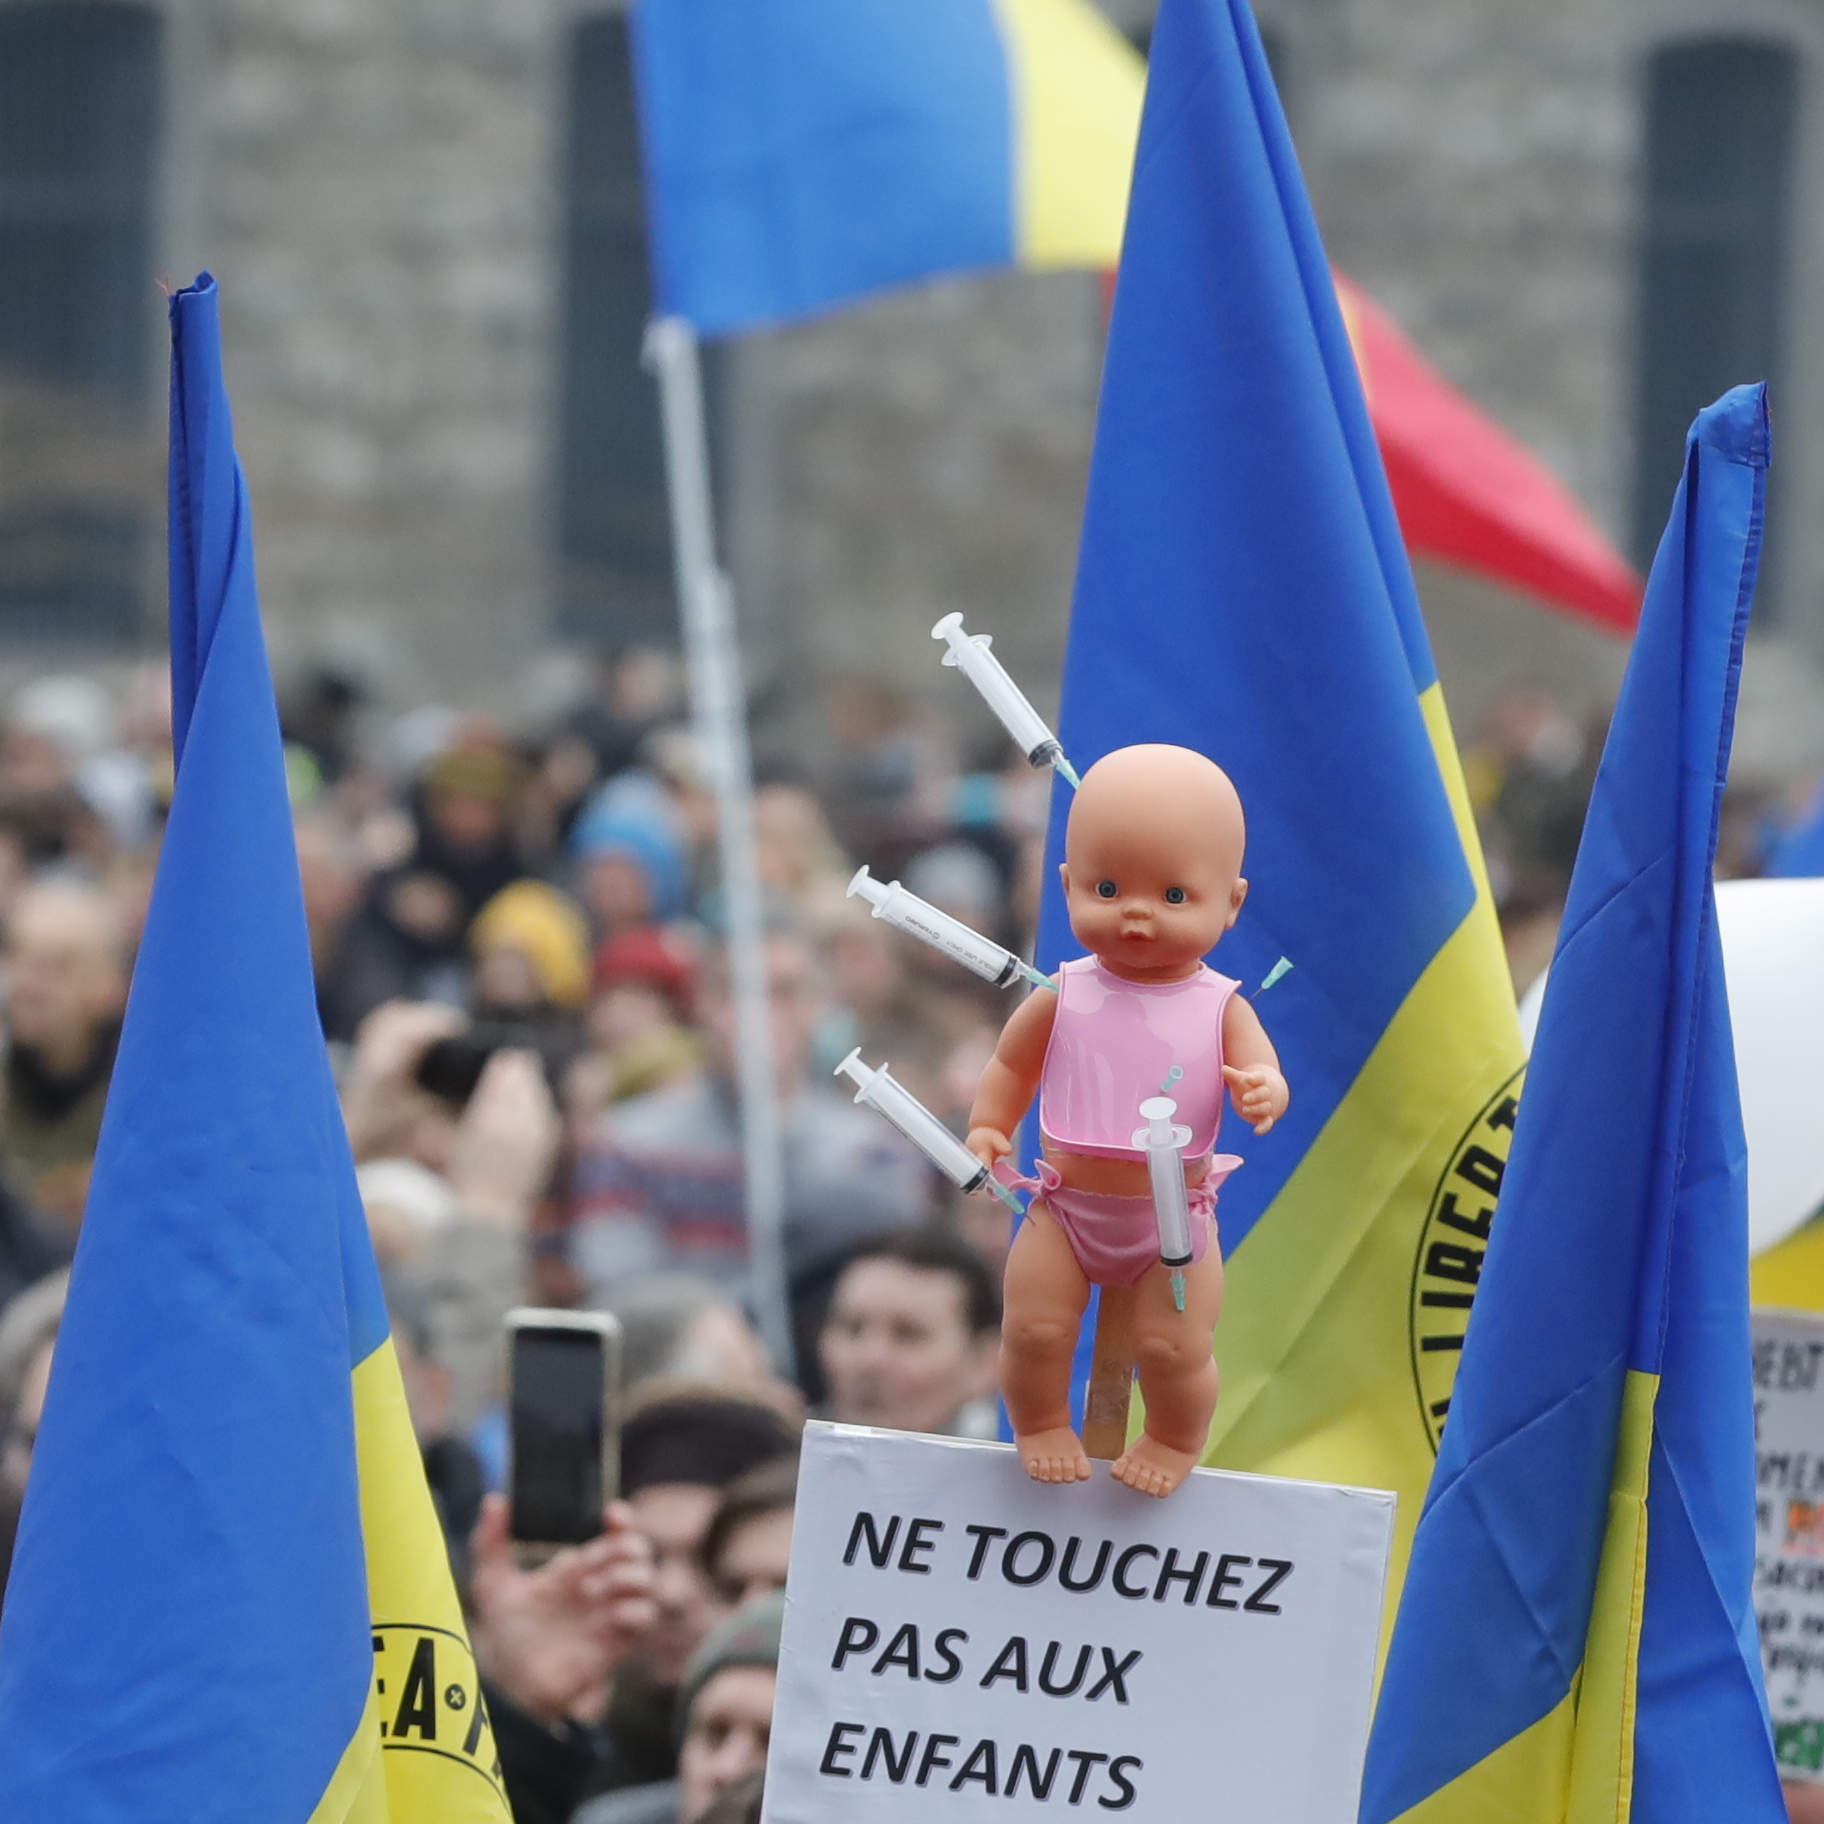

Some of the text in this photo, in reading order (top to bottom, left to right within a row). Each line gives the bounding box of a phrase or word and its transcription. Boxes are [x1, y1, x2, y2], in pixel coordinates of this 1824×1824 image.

[842, 1511, 1296, 1616] NE TOUCHEZ
[830, 1616, 1143, 1704] PAS AUX
[818, 1721, 1144, 1811] ENFANTS
